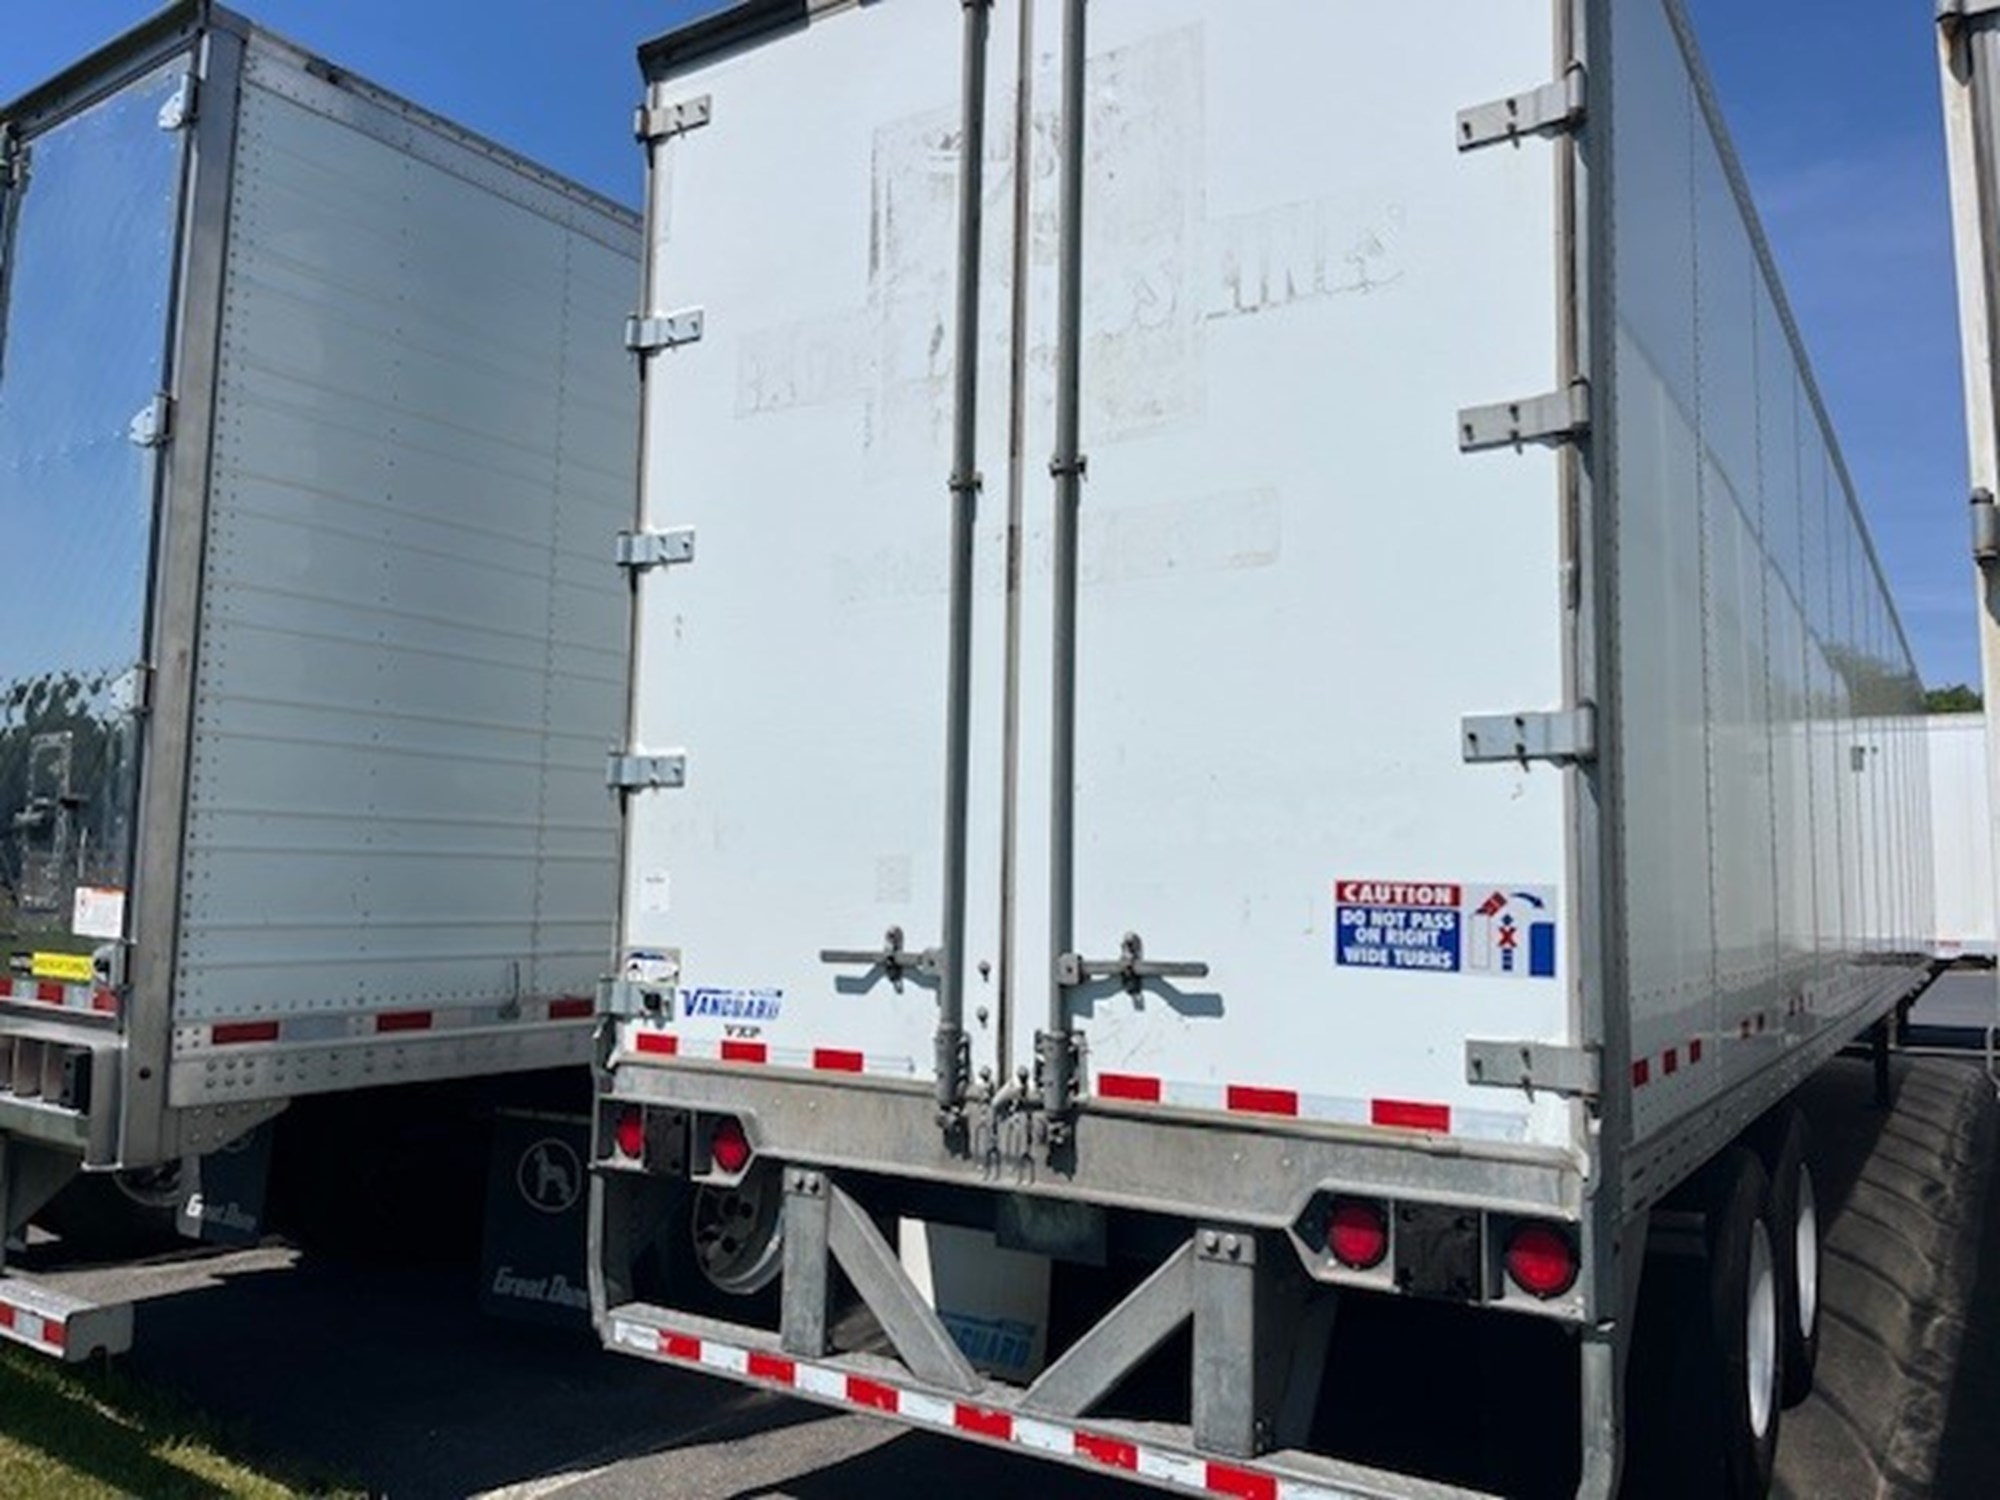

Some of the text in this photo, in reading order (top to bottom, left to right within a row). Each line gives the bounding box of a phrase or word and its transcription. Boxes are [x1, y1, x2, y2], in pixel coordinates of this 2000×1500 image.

[1343, 883, 1451, 905] CAUTION
[1341, 909, 1454, 930] DO NOT PASS
[1355, 927, 1440, 946] ON RIGHT
[1343, 946, 1453, 967] WIDE TURNS
[680, 987, 782, 1020] VANGUARD
[493, 1265, 588, 1310] Great Dan
